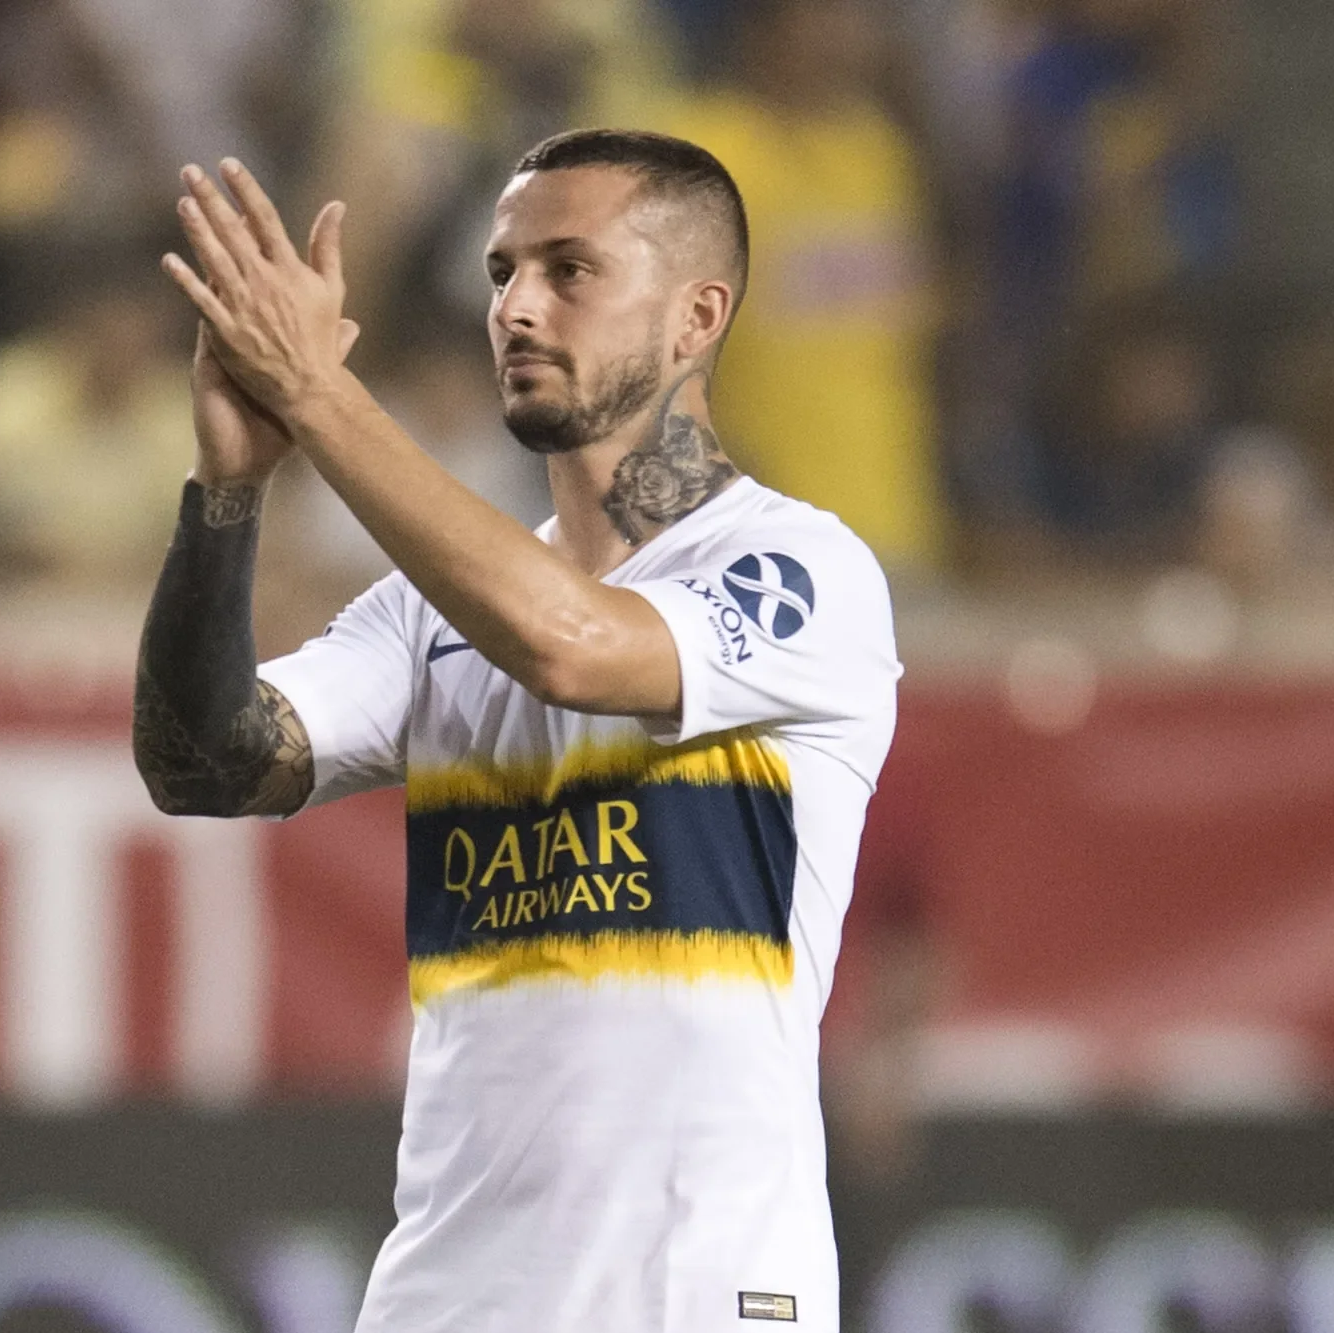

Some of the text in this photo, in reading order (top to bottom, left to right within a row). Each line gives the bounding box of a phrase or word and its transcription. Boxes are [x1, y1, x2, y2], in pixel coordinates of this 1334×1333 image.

[672, 578, 753, 664] AXION
[444, 799, 648, 902] QATAR
[472, 871, 652, 931] AIRWAYS
